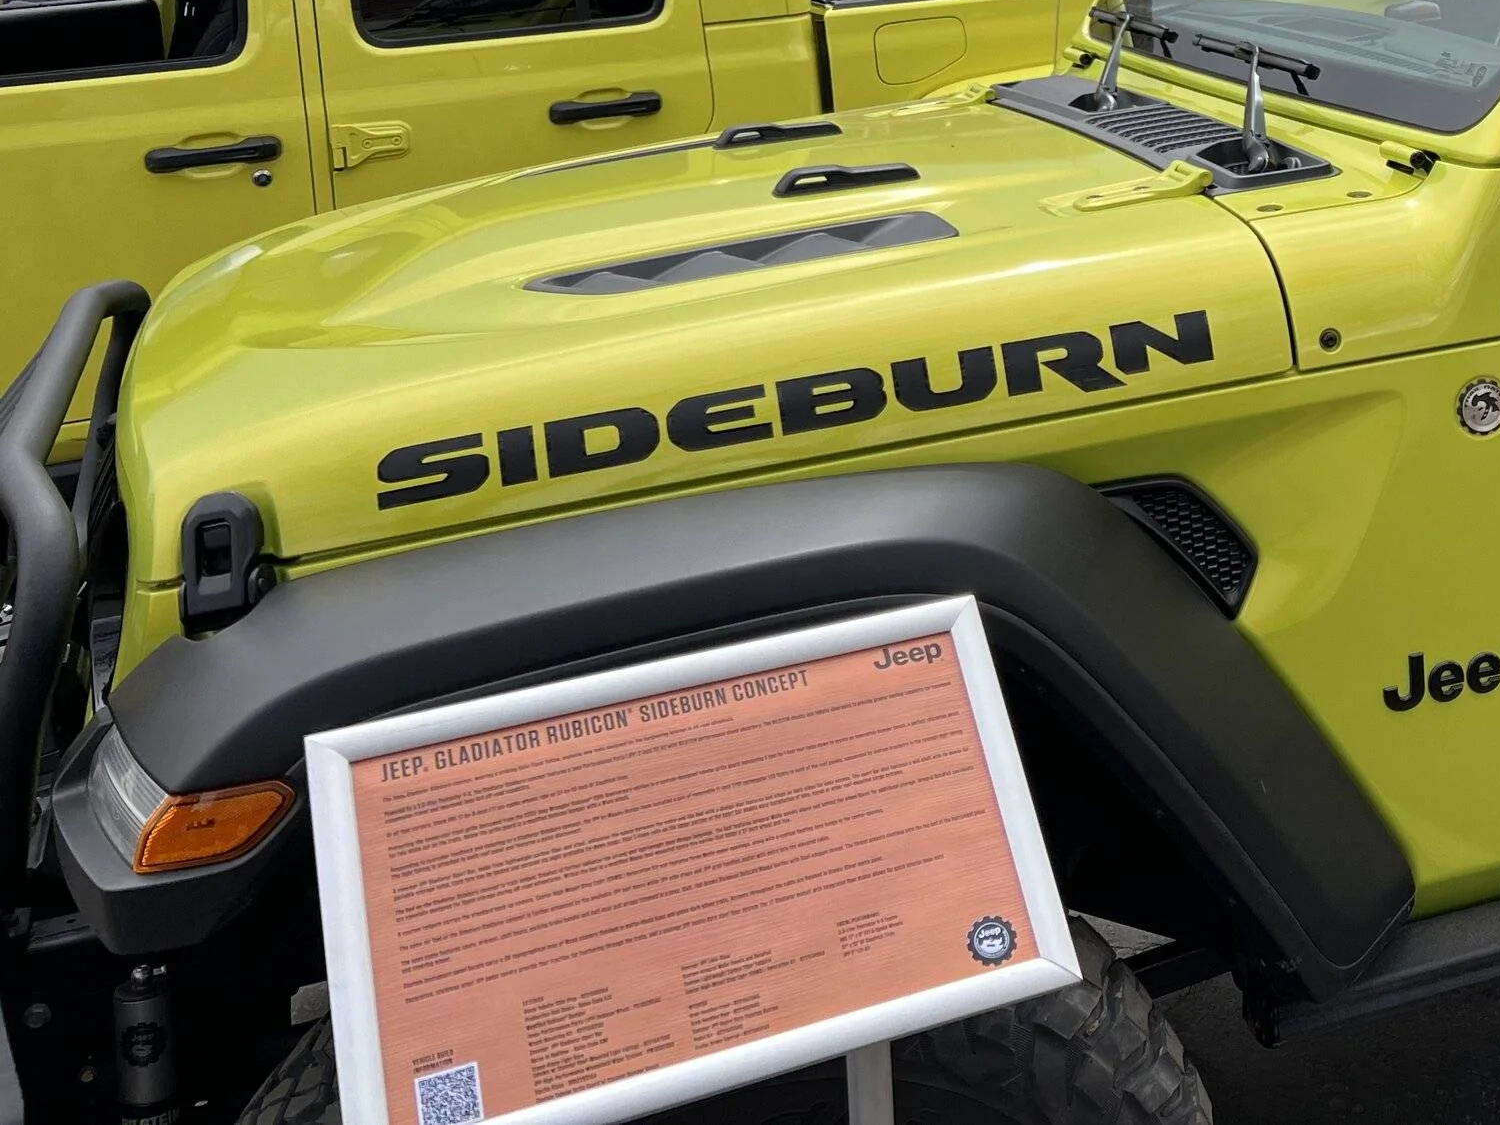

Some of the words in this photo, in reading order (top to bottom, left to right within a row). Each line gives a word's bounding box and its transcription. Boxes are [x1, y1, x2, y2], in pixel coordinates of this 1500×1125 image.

[376, 310, 1215, 510] SIDEBURN
[873, 642, 943, 671] Jeep
[435, 730, 541, 771] GLADIATOR
[547, 709, 630, 745] RUBICON
[640, 684, 727, 723] SIDEBURN
[732, 669, 809, 701] CONCEPT
